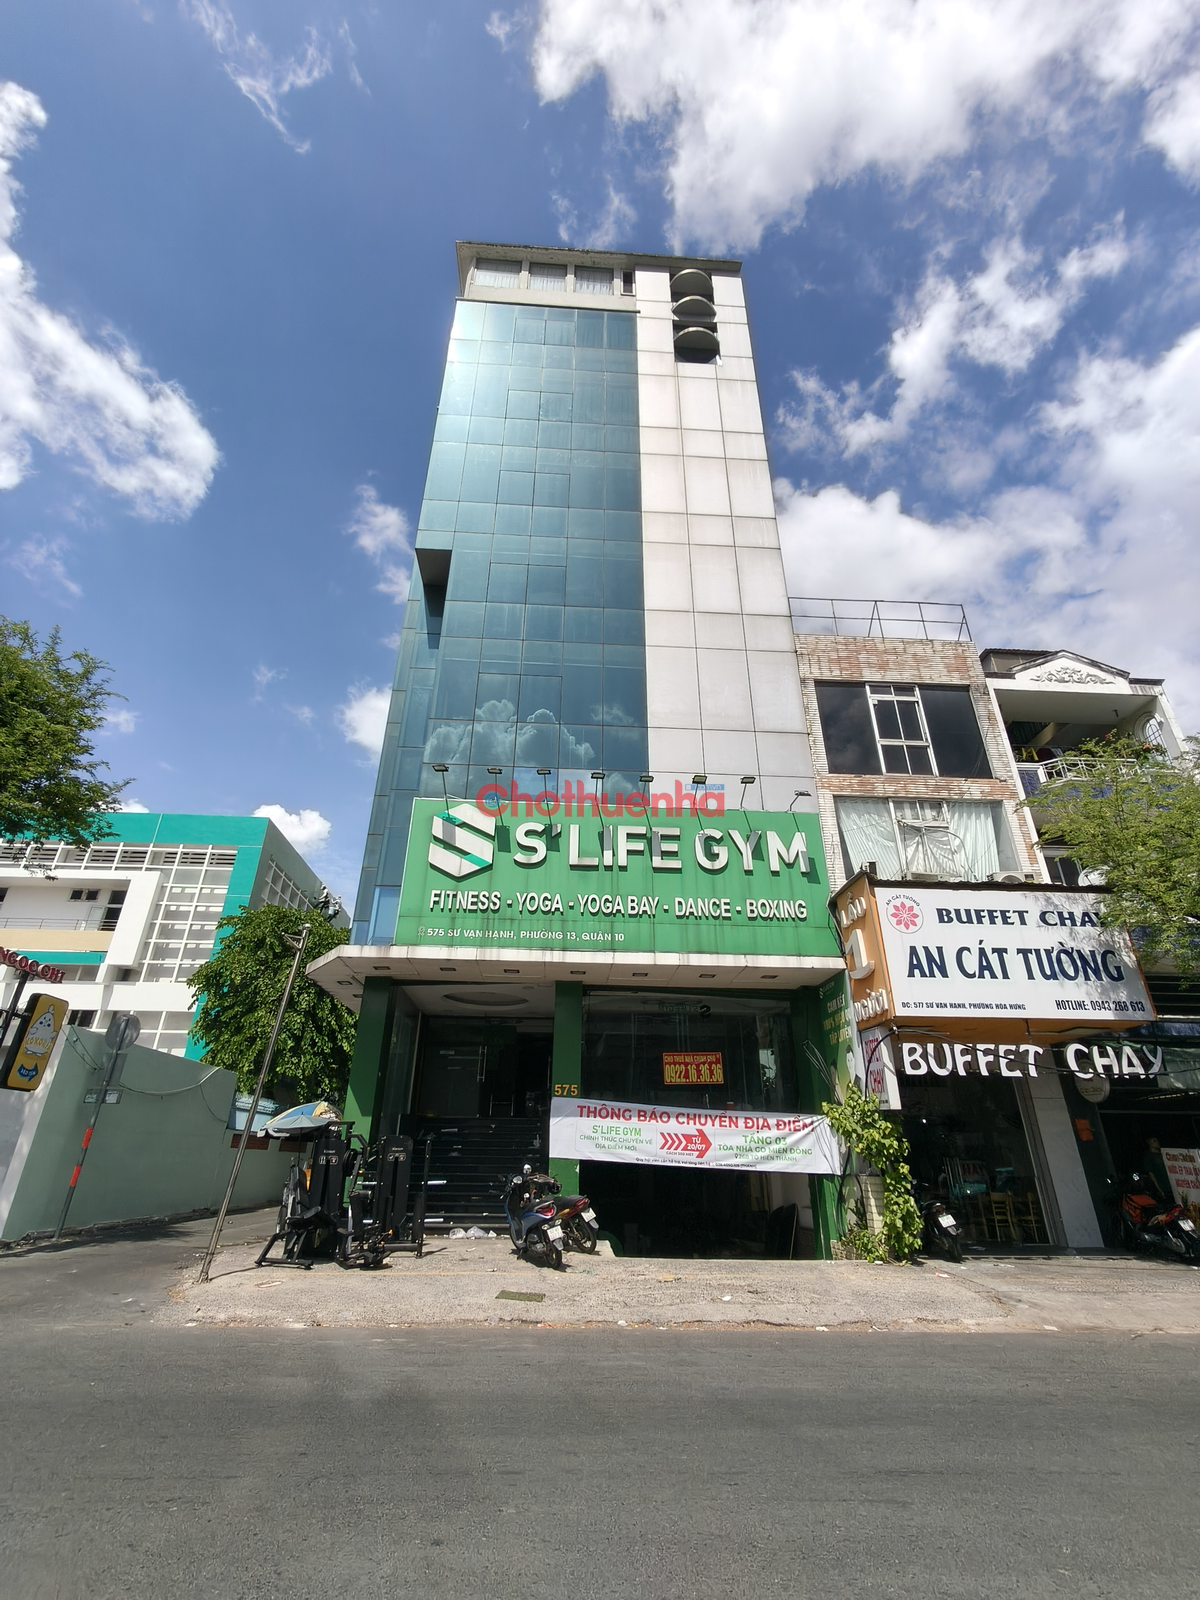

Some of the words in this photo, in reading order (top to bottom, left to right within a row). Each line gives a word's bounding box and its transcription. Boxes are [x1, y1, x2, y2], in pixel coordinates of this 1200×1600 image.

[513, 822, 682, 872] S'LIFE
[695, 828, 811, 874] GYM
[430, 890, 501, 912] FITNESS
[517, 892, 563, 914] YOGA
[577, 894, 625, 915] YOGA
[627, 896, 659, 916] BAY
[675, 897, 731, 918] DANCE
[746, 898, 808, 920] BOXING
[936, 908, 1029, 926] BUFFET
[427, 928, 444, 937] 575
[463, 929, 482, 939] VẠN
[485, 930, 517, 940] HẠNH,
[520, 929, 563, 940] PHƯỜNG
[566, 931, 579, 941] 13,
[582, 930, 611, 942] QUẬN
[615, 933, 624, 941] 10
[845, 928, 875, 980] 1
[907, 945, 949, 978] AN
[955, 940, 1011, 979] CÁT
[1016, 941, 1125, 982] TƯỜNG
[914, 1001, 924, 1009] 577
[1055, 999, 1089, 1010] HOTLINE:
[1090, 1000, 1112, 1011] 0943
[1112, 1001, 1129, 1011] 268
[1130, 1001, 1146, 1012] 613
[902, 1042, 1044, 1078] BUFFET
[1066, 1042, 1162, 1079] CHAY
[665, 1063, 722, 1082] 0922.16.36.36
[554, 1084, 578, 1097] 575
[577, 1103, 632, 1121] THÔNG
[637, 1107, 671, 1124] BÁO
[675, 1110, 739, 1128] CHUYỂN
[743, 1116, 771, 1133] ĐỊA
[775, 1115, 815, 1132] ĐIỂM
[623, 1127, 641, 1137] GYM
[691, 1135, 702, 1143] TỪ
[687, 1143, 706, 1151] 20/07
[775, 1136, 788, 1145] 03
[736, 1143, 753, 1153] NHÀ
